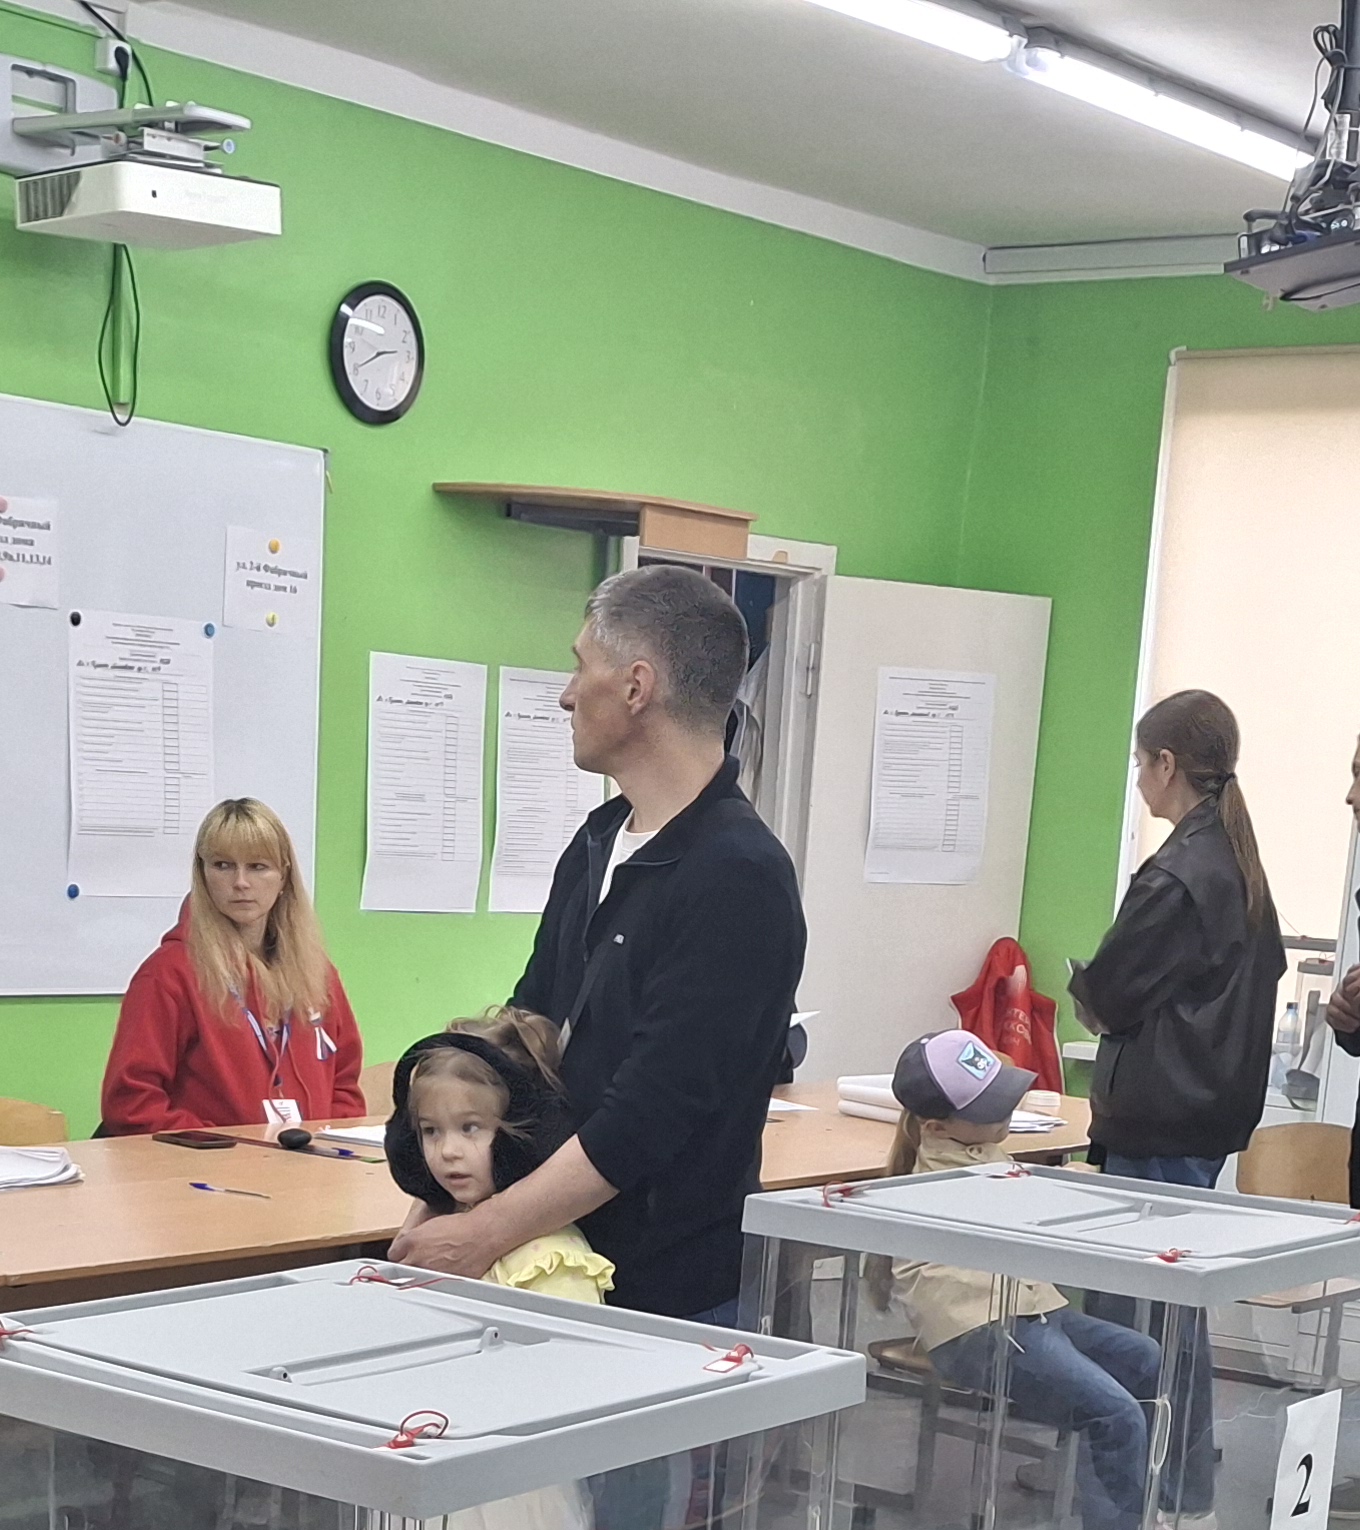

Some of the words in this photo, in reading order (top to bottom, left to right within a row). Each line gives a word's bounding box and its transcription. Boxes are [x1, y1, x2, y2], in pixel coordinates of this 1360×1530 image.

[377, 305, 387, 319] 12
[401, 330, 411, 344] 2
[406, 350, 411, 363] 3
[363, 379, 369, 392] 7
[375, 387, 382, 400] 6
[1290, 1453, 1313, 1517] 2
